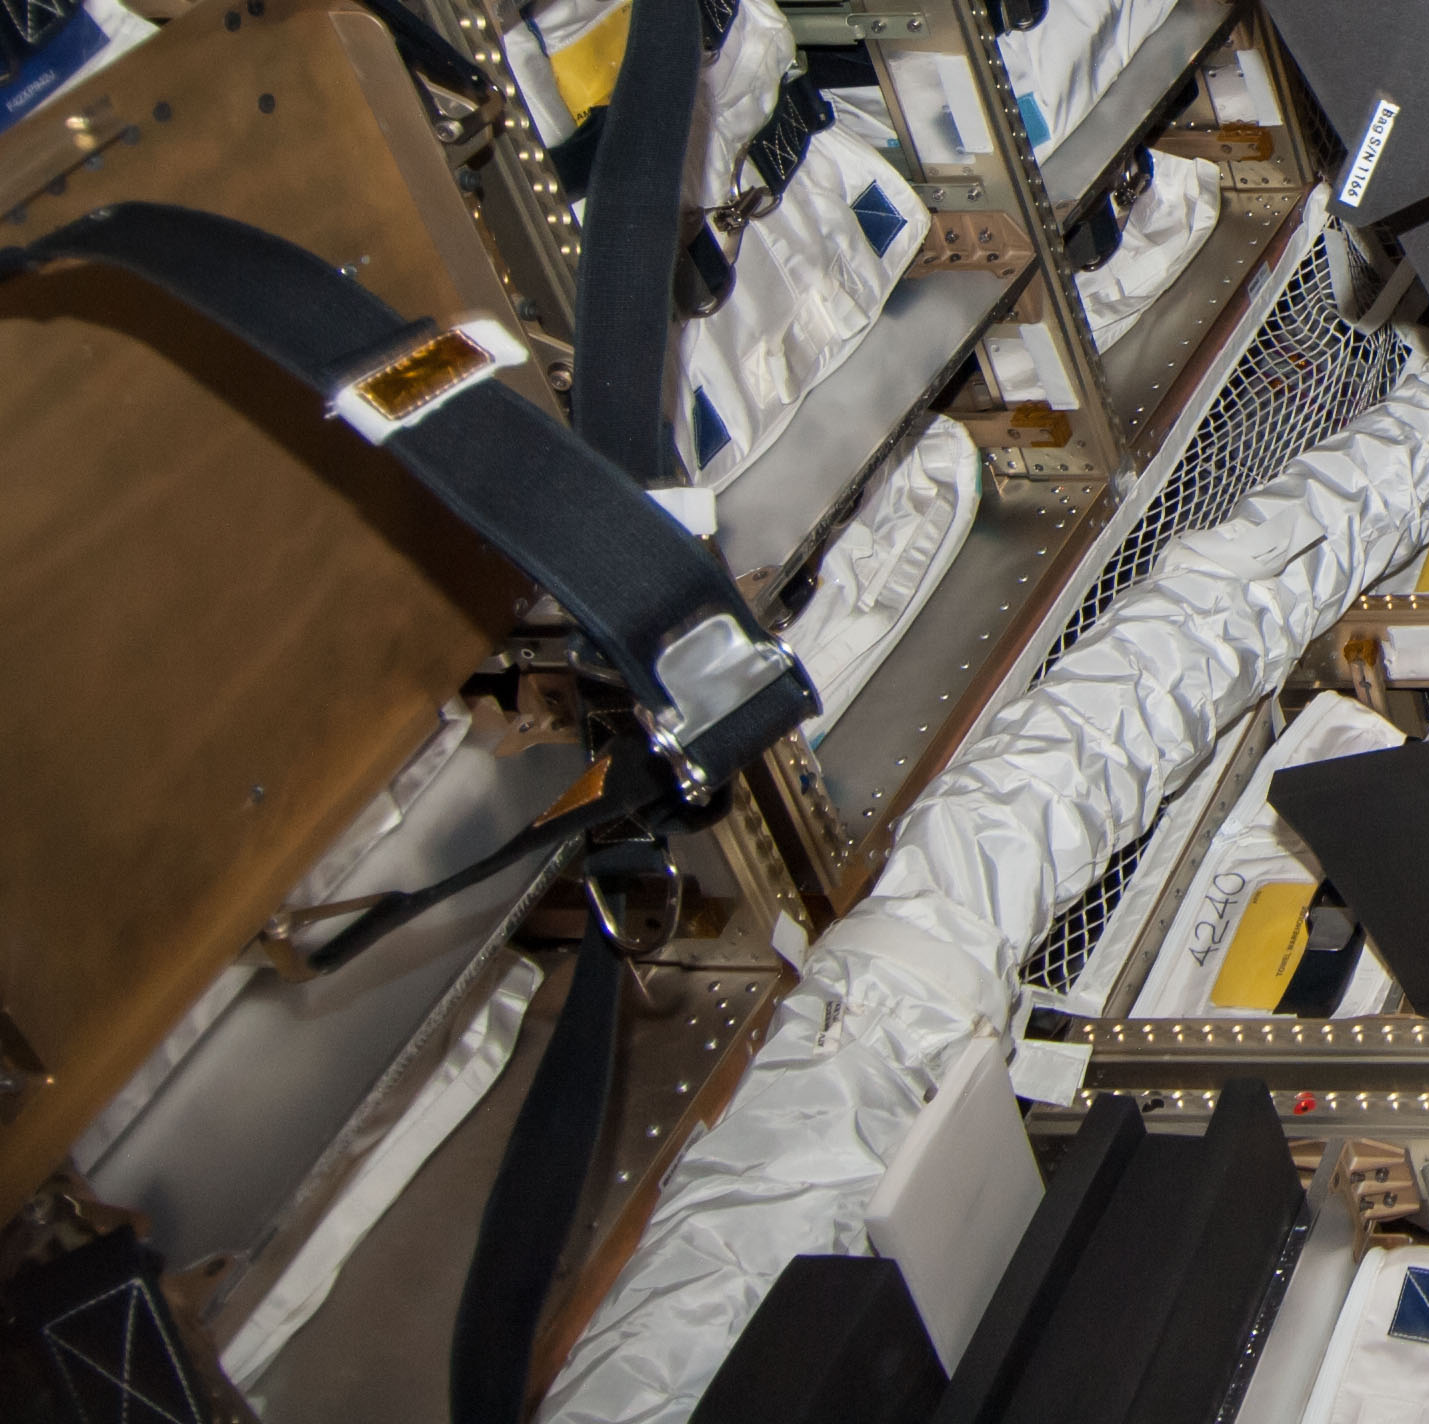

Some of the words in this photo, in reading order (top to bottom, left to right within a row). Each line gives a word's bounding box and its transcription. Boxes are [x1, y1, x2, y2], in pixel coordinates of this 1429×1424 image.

[1372, 108, 1394, 134] Bag
[1362, 136, 1382, 162] S/N
[1347, 167, 1369, 197] 1166
[1190, 872, 1246, 968] 4240
